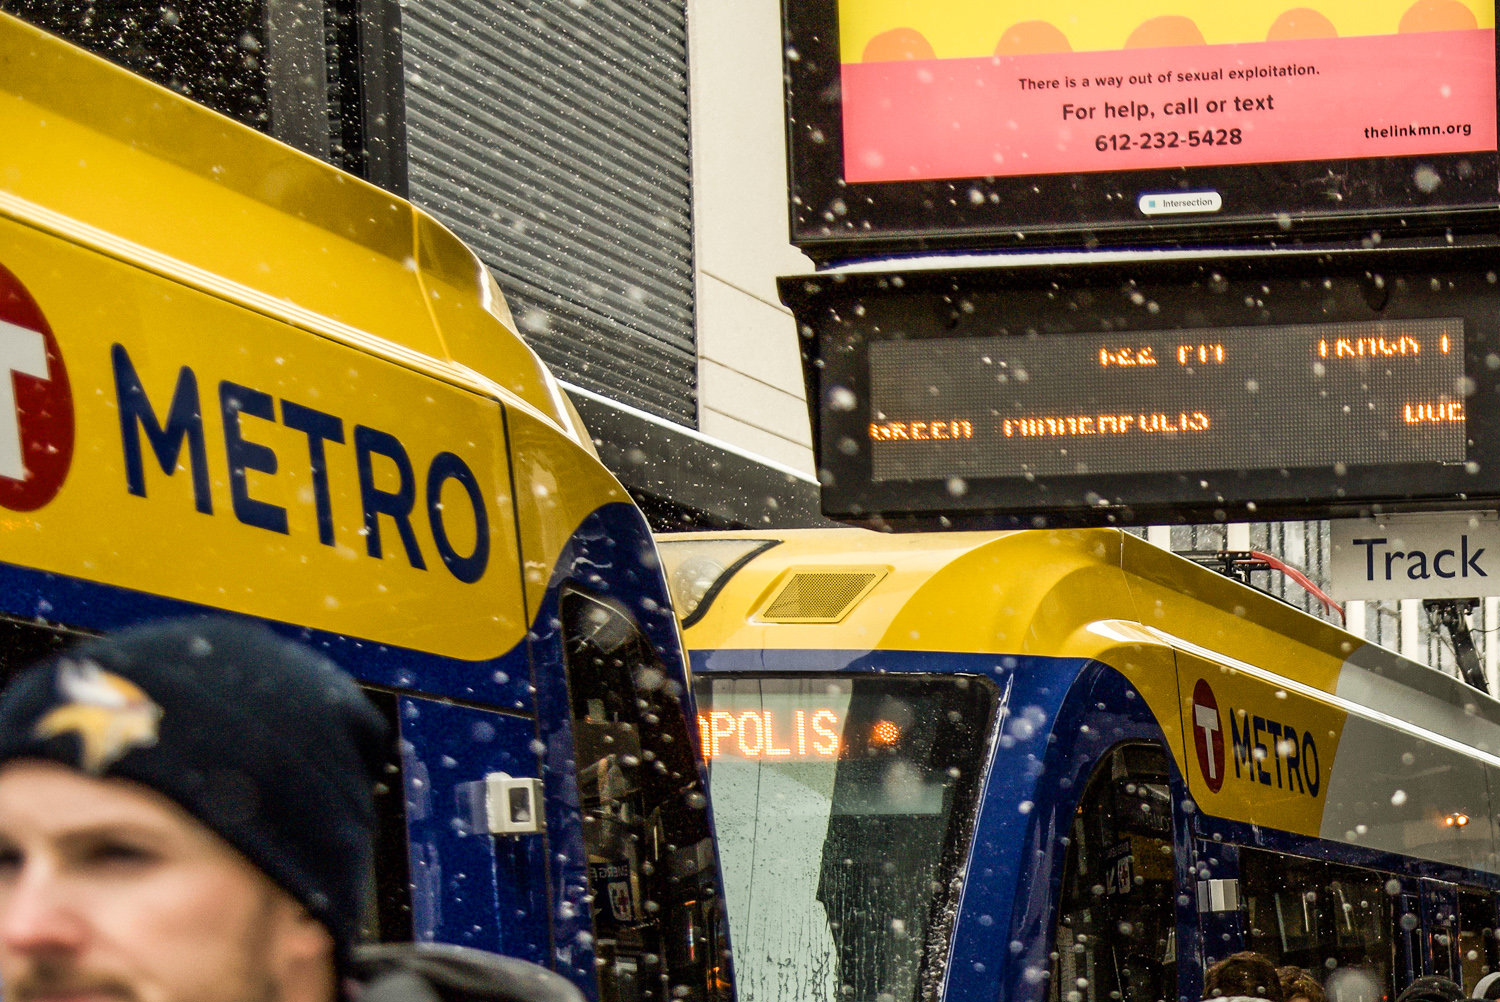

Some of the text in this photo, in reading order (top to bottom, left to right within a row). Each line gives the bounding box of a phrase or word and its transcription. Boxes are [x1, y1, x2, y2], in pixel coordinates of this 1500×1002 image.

[1018, 64, 1320, 90] There is a way out of sexual exploitation.
[1062, 94, 1274, 121] For help, call or text
[1094, 128, 1243, 152] 612-232-5428
[1364, 123, 1472, 140] thelinkmn.org
[1162, 197, 1213, 209] Intersection
[111, 342, 490, 585] METRO
[1352, 534, 1488, 581] Track
[1230, 707, 1320, 798] METRO
